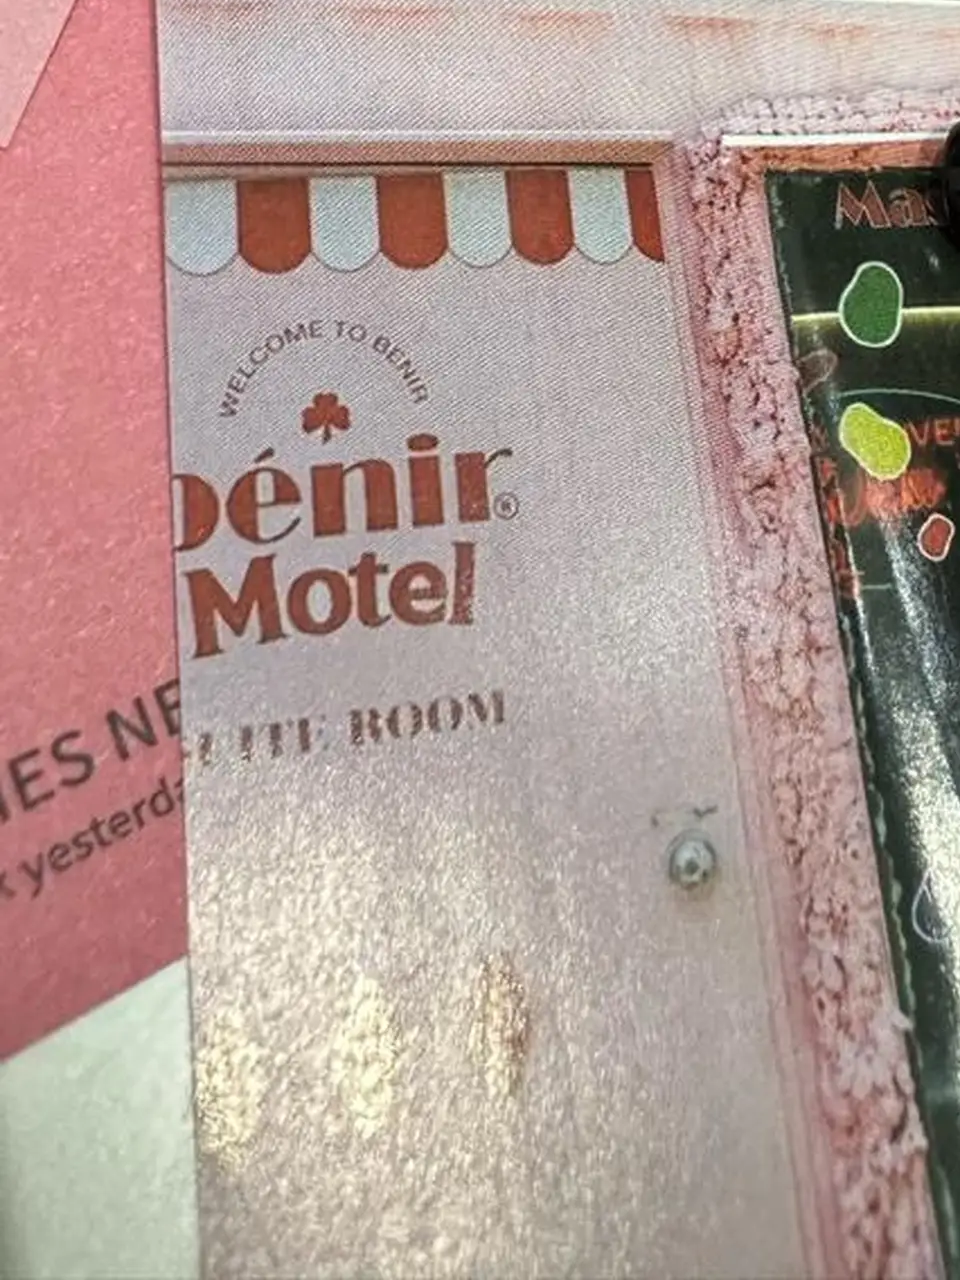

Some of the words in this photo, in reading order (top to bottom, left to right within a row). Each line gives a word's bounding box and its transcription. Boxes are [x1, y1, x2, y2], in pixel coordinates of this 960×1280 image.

[219, 320, 323, 418] WELCOME
[334, 320, 368, 343] TO
[372, 333, 430, 405] BENIR
[183, 541, 476, 659] Motel
[349, 689, 505, 749] ROOM
